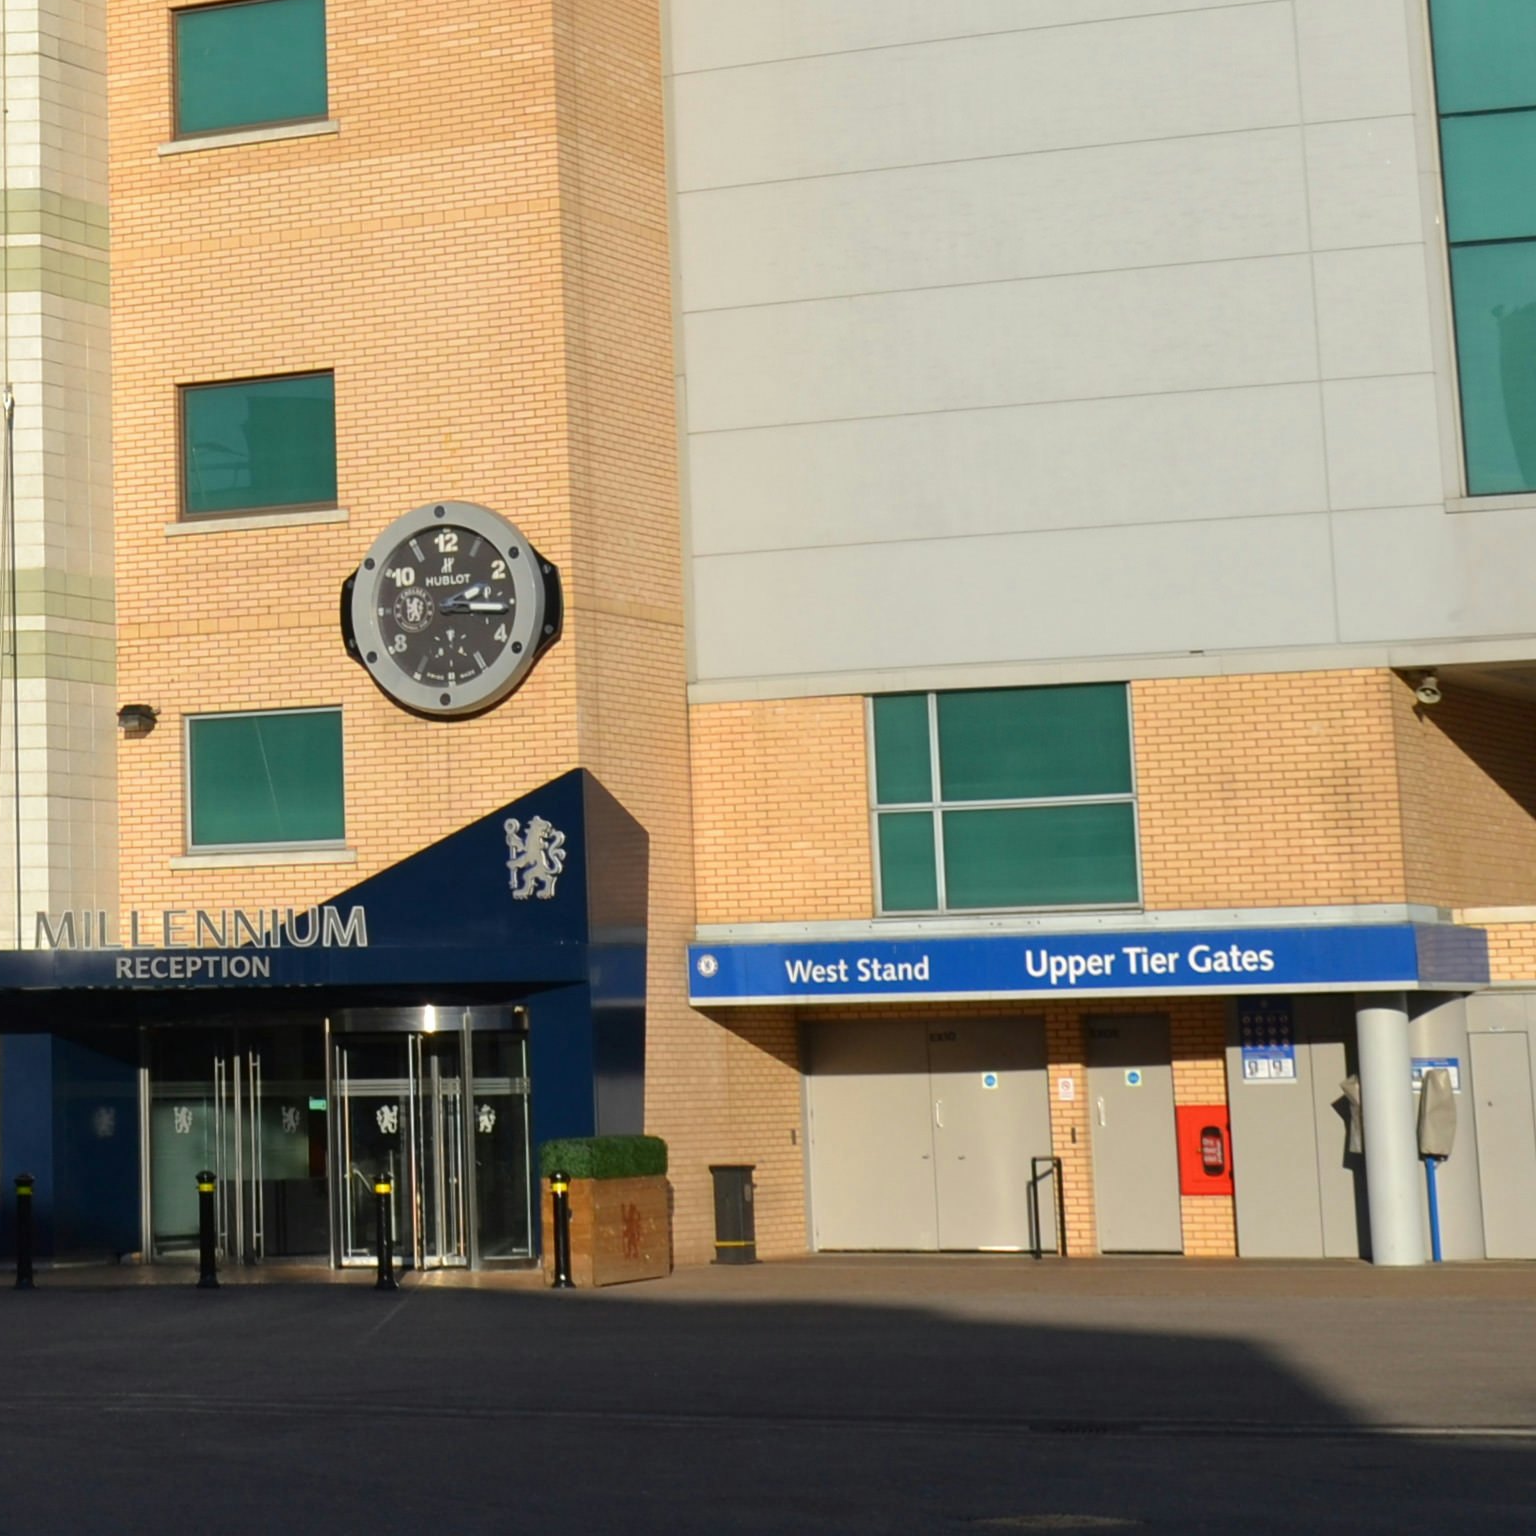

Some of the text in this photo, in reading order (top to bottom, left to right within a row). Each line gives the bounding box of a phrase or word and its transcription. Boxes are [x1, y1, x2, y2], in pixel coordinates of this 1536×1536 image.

[434, 532, 459, 553] 12
[391, 566, 416, 587] 10
[425, 573, 471, 586] HUBLOT
[491, 559, 506, 579] 2
[394, 633, 408, 653] 8
[493, 623, 508, 643] 4
[34, 905, 369, 949] MILLENNIUM
[116, 956, 271, 980] RECEPTION
[784, 954, 930, 984] West Stand
[1024, 944, 1275, 985] Upper Tier Gates
